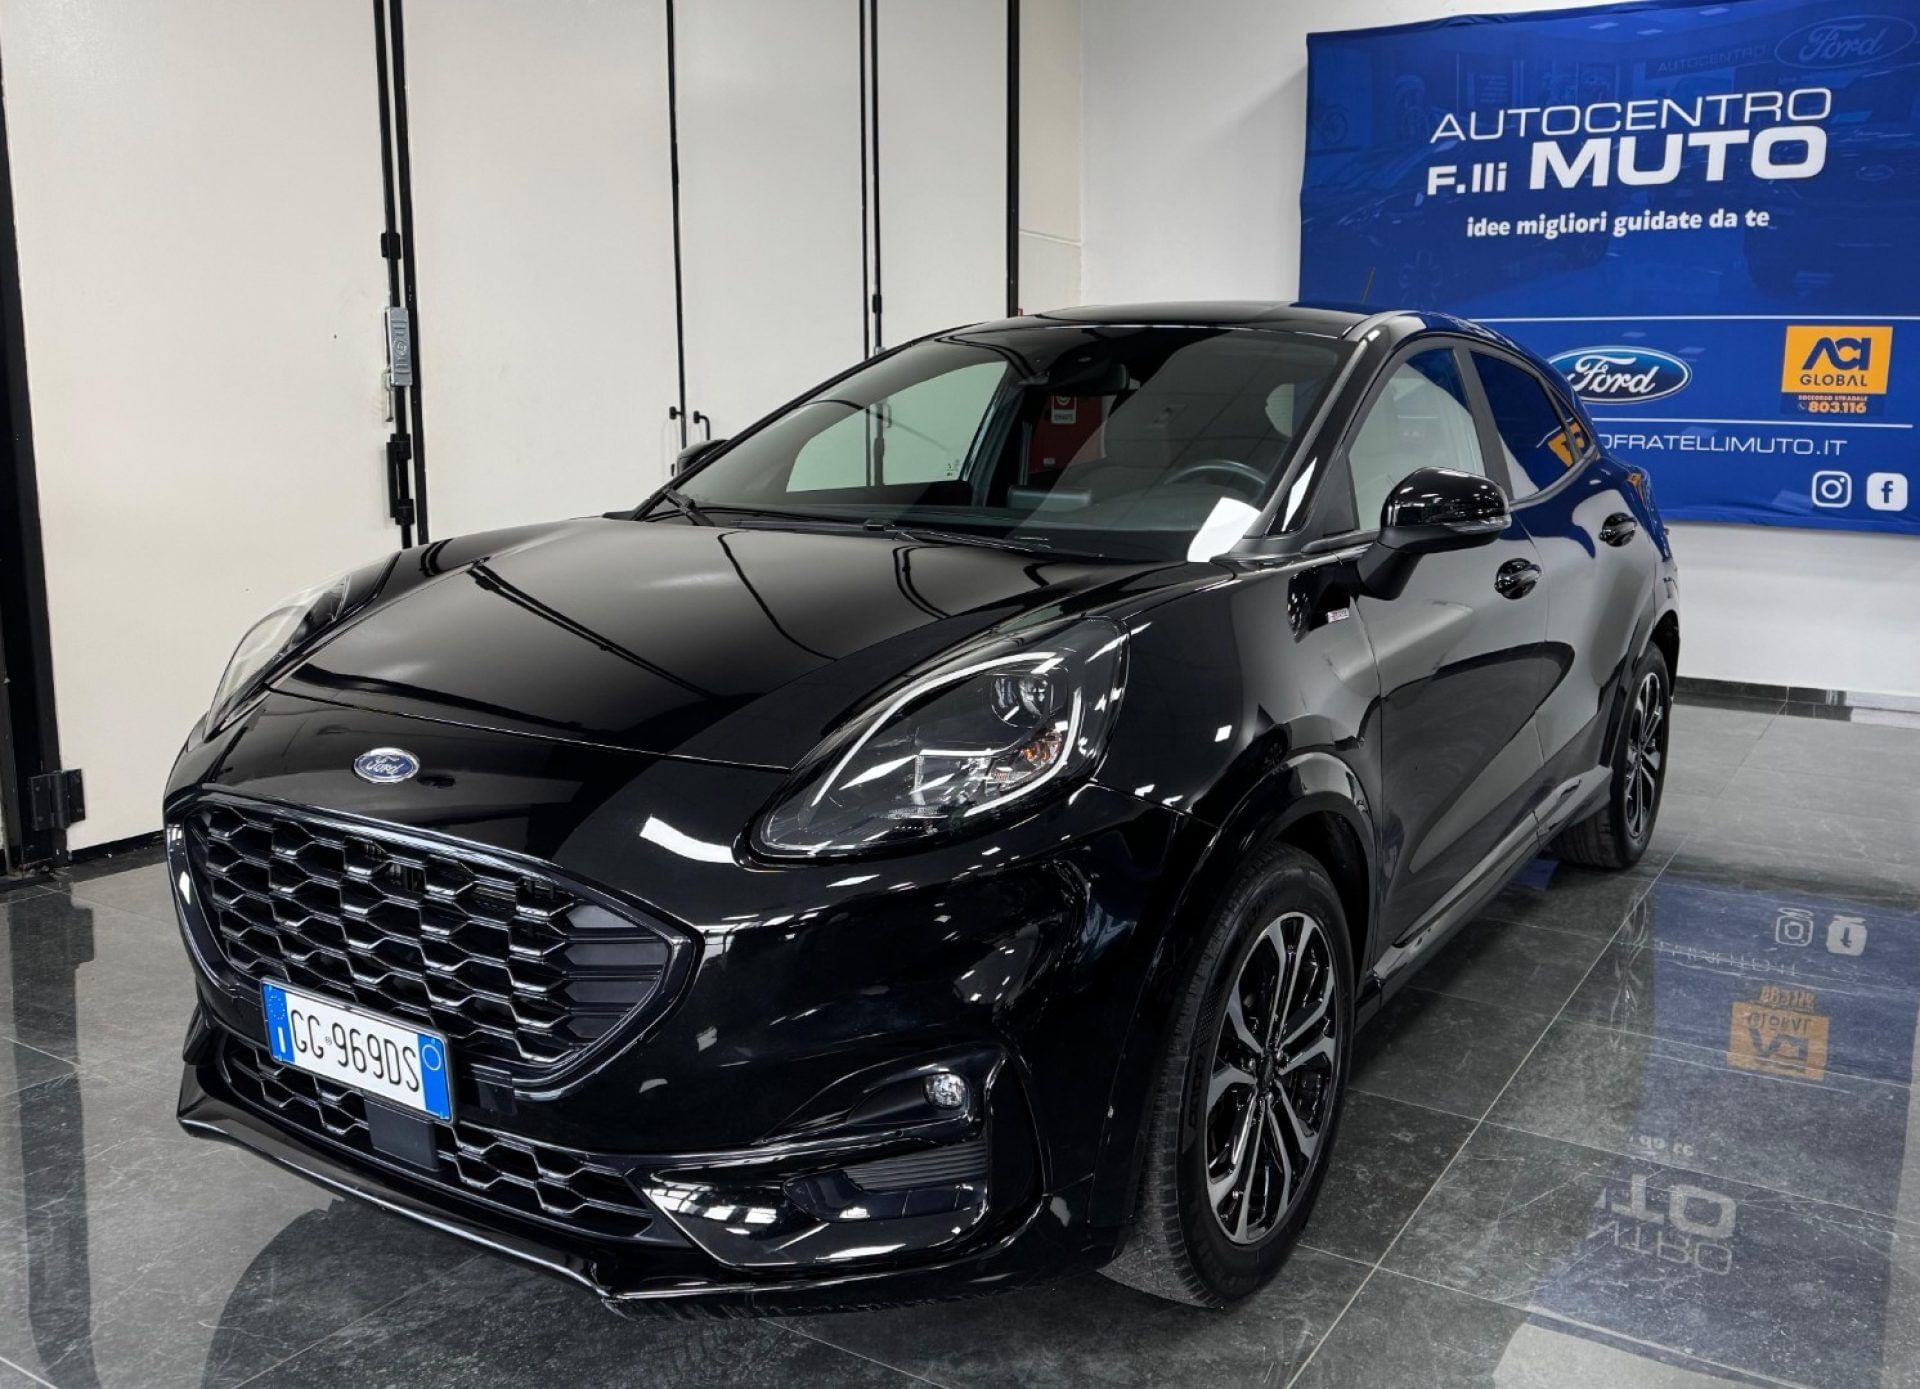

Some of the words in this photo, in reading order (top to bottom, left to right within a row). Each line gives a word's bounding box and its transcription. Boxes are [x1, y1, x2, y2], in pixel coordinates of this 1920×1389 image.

[1802, 22, 1888, 61] Ford
[1657, 43, 1767, 74] AUTOCENTRO
[1430, 87, 1832, 143] AUTOCENTRO
[1426, 162, 1507, 195] F.lli
[1529, 125, 1828, 190] MUTO
[1466, 216, 1511, 238] idee
[1516, 211, 1608, 240] migliori
[1612, 209, 1703, 238] guidate
[1708, 207, 1738, 229] da
[1744, 208, 1771, 228] te
[1801, 337, 1872, 371] ACI
[1567, 353, 1661, 395] Ford
[1799, 374, 1869, 388] GLOBAL
[1807, 400, 1868, 414] 803.116
[366, 755, 406, 776] Ford
